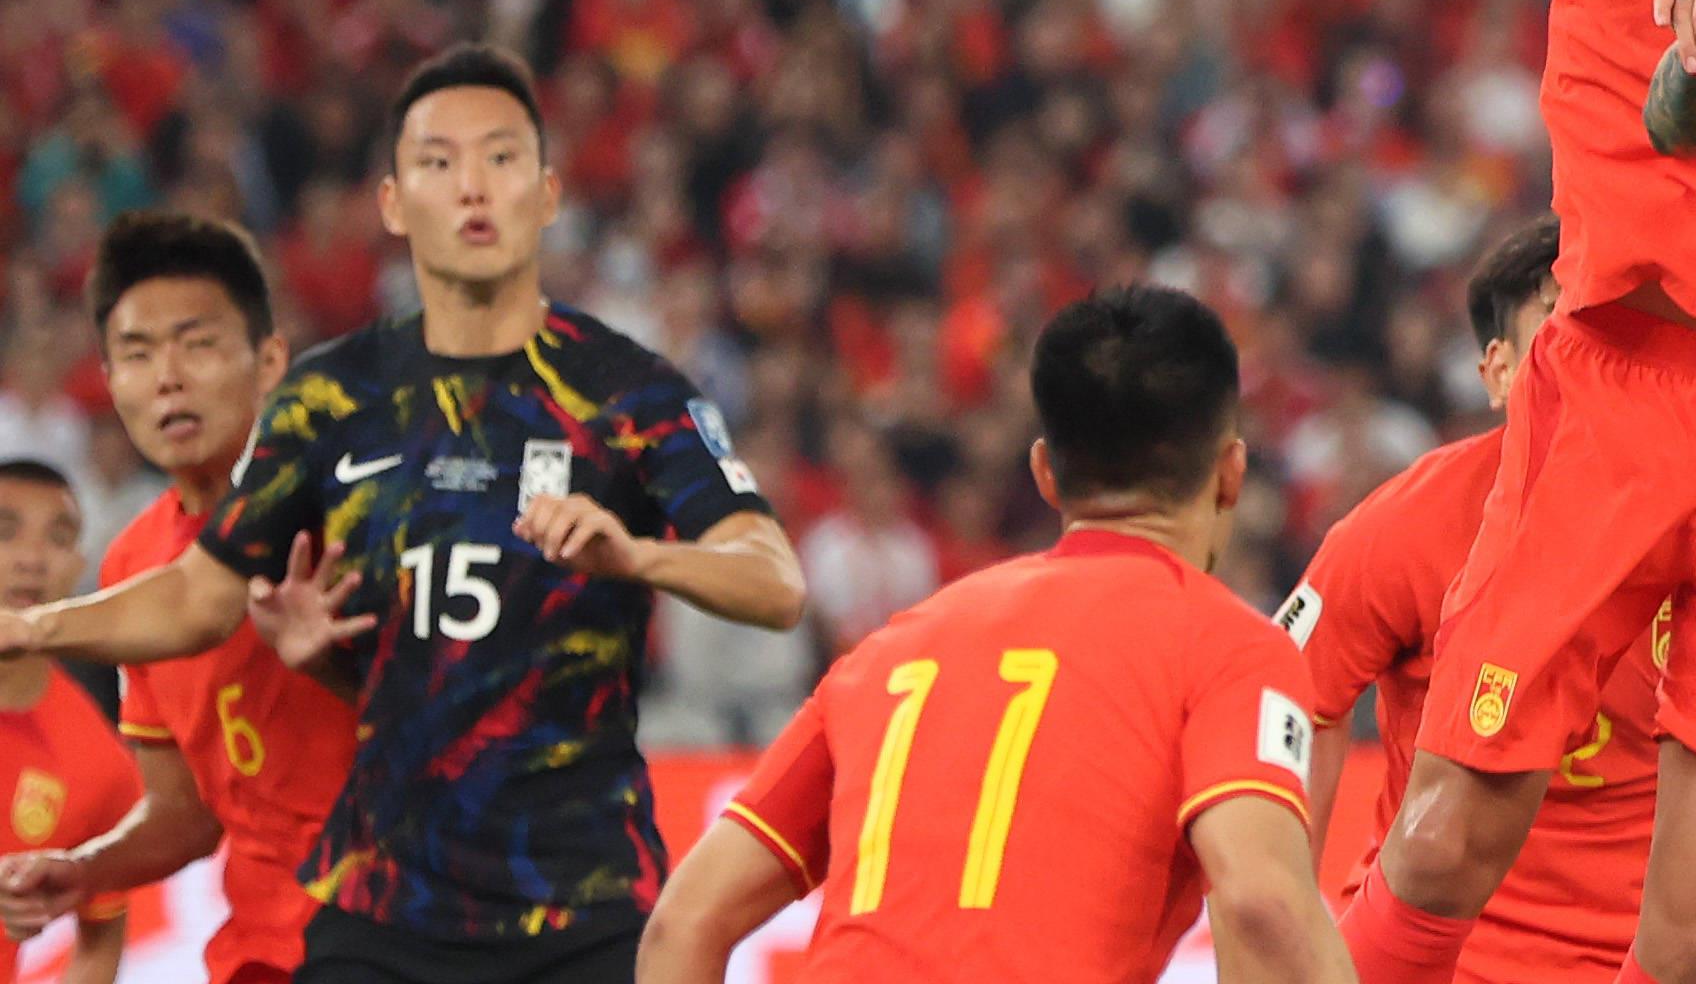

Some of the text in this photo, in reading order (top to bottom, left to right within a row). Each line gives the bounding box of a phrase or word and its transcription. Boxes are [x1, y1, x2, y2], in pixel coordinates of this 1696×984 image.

[400, 543, 501, 642] 15
[217, 684, 265, 777] 6
[850, 648, 1059, 916] 11
